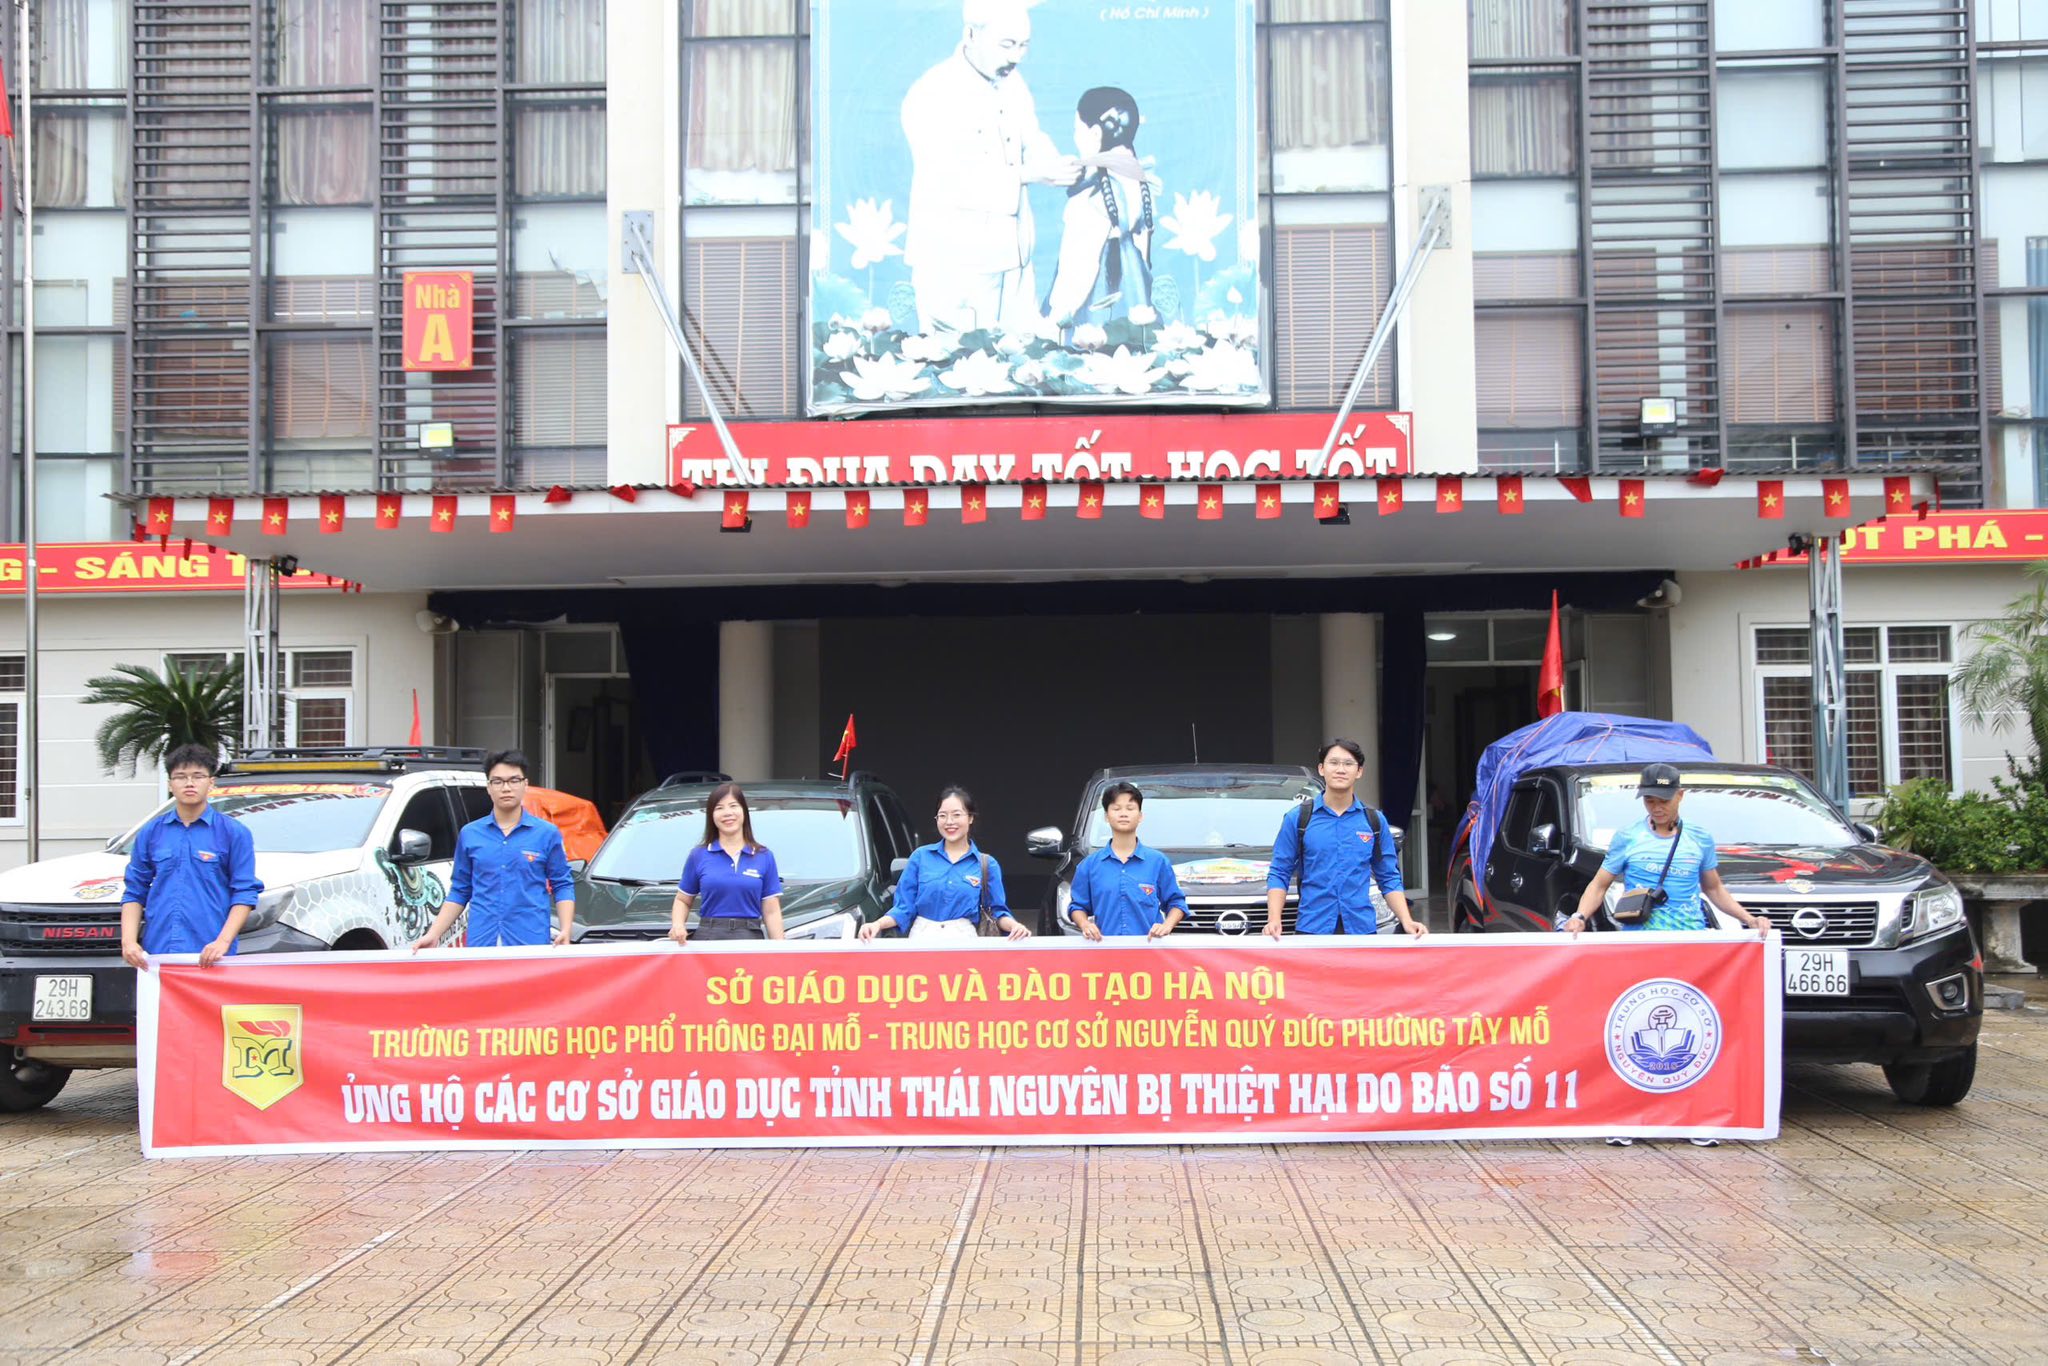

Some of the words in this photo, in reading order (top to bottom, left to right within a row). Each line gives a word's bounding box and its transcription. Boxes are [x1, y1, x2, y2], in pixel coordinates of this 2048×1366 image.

[415, 283, 461, 310] Nhà
[418, 314, 455, 362] A
[1903, 520, 2008, 549] PHÁ
[74, 552, 209, 579] SÁNG
[43, 927, 115, 939] NISSAN
[1800, 953, 1834, 972] 29H
[49, 979, 78, 998] 29H
[706, 967, 754, 1005] SỞ
[763, 969, 845, 1004] GIÁO
[857, 974, 928, 1009] DỤC
[939, 967, 988, 1002] VÀ
[997, 967, 1071, 1001] ĐÀO
[1081, 971, 1152, 1006] TẠO
[1164, 966, 1214, 1000] HÀ
[1225, 965, 1286, 1006] NỘI
[1788, 974, 1847, 993] 466.66
[35, 1000, 89, 1019] 243.68
[1615, 992, 1647, 1030] TRUNG
[1650, 987, 1679, 996] HỌC
[369, 1023, 470, 1058] TRƯỜNG
[476, 1026, 559, 1057] TRUNG
[567, 1025, 618, 1060] HỌC
[625, 1013, 676, 1053] PHỔ
[681, 1018, 766, 1053] THÔNG
[772, 1023, 814, 1057] ĐẠI
[822, 1012, 862, 1051] MỖ
[886, 1020, 971, 1050] TRUNG
[978, 1020, 1029, 1054] HỌC
[1036, 1019, 1070, 1048] CƠ
[1075, 1011, 1109, 1049] SỞ
[1115, 1009, 1218, 1048] NGUYỄN
[1225, 1018, 1276, 1049] QUÝ
[1282, 1013, 1335, 1048] ĐỨC
[1341, 1012, 1446, 1047] PHƯỜNG
[1451, 1012, 1503, 1046] TÂY
[1509, 1005, 1551, 1045] MỖ
[341, 1073, 411, 1124] ỦNG
[420, 1075, 465, 1131] HỘ
[475, 1073, 537, 1123] CÁC
[546, 1080, 591, 1122] CƠ
[597, 1067, 643, 1121] SỞ
[650, 1070, 726, 1120] GIÁO
[735, 1077, 801, 1127] DỤC
[809, 1065, 892, 1118] TỈNH
[900, 1067, 980, 1117] THÁI
[989, 1065, 1128, 1117] NGUYÊN
[1137, 1073, 1172, 1122] BỊ
[1180, 1064, 1280, 1122] THIỆT
[1289, 1073, 1348, 1122] HẠI
[1357, 1072, 1402, 1114] DO
[1411, 1064, 1480, 1113] BÃO
[1489, 1056, 1532, 1111] SỐ
[1545, 1070, 1578, 1109] 11
